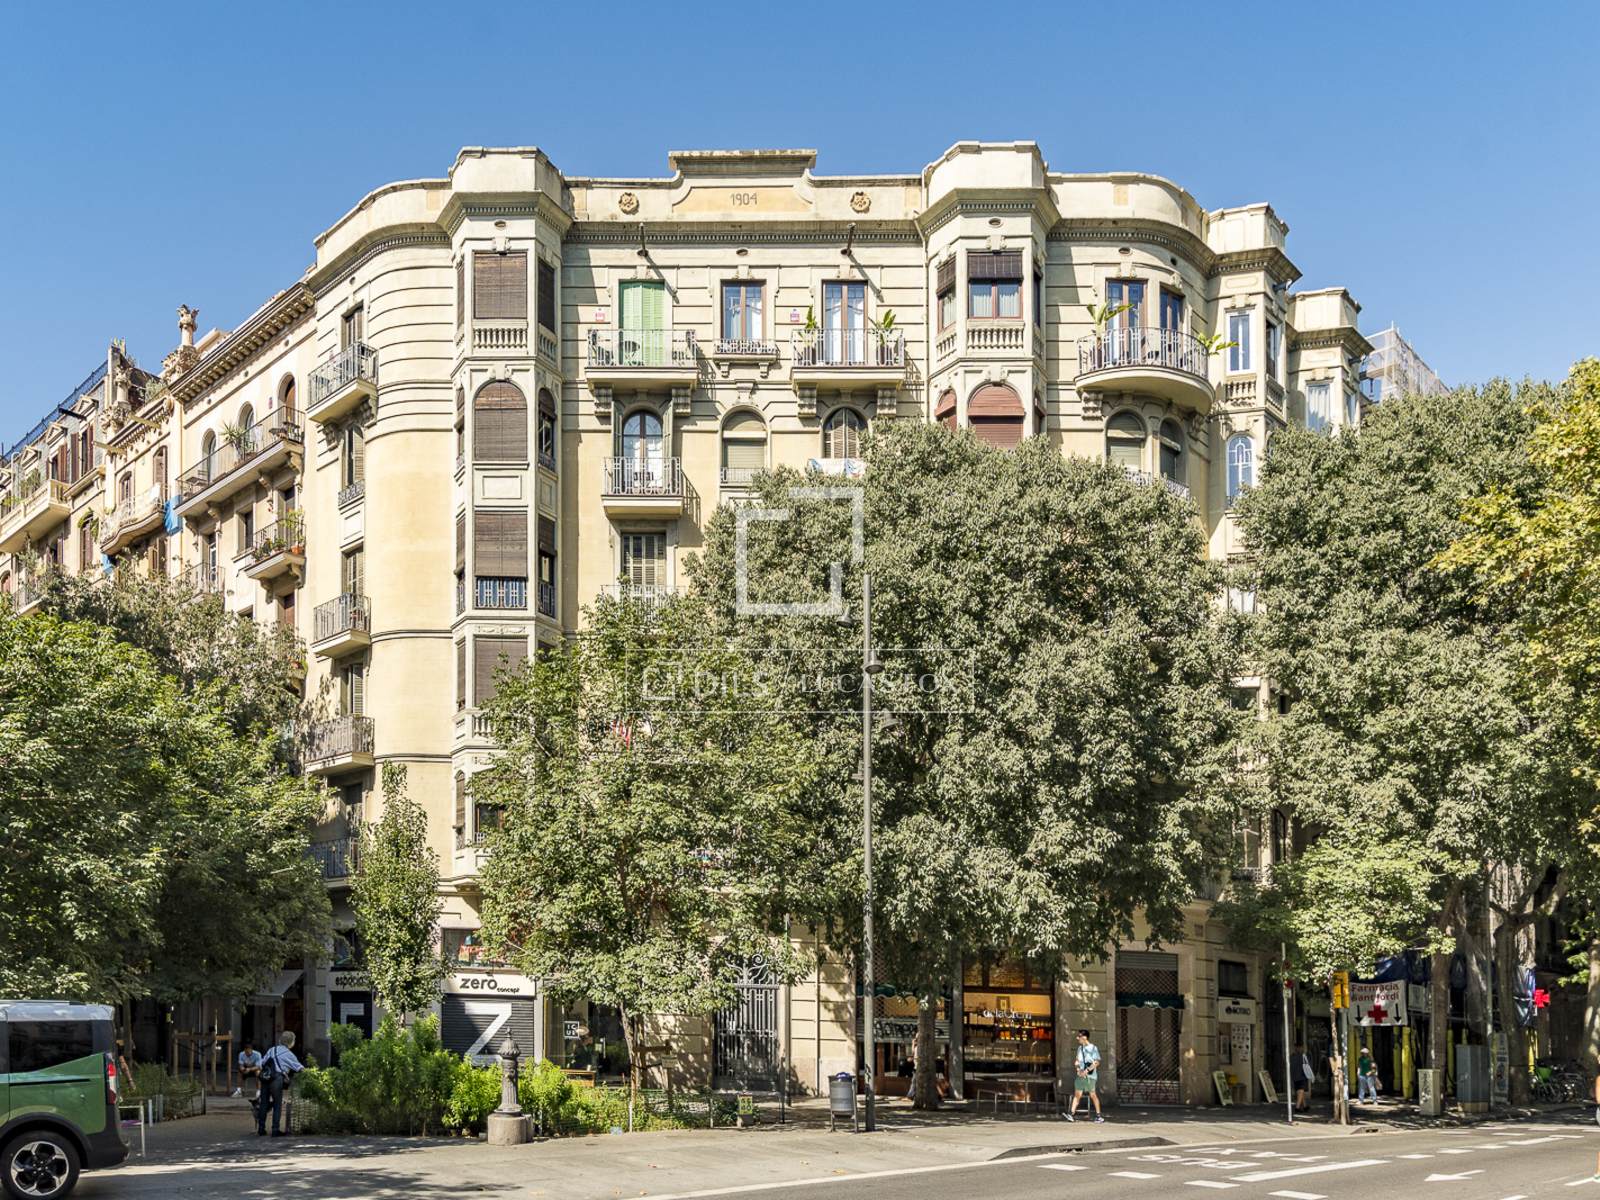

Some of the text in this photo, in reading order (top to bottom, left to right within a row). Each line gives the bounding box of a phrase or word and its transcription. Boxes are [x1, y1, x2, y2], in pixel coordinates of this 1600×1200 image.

[730, 193, 758, 206] 1904
[459, 977, 520, 994] zero concept
[1128, 1154, 1263, 1170] BUS
